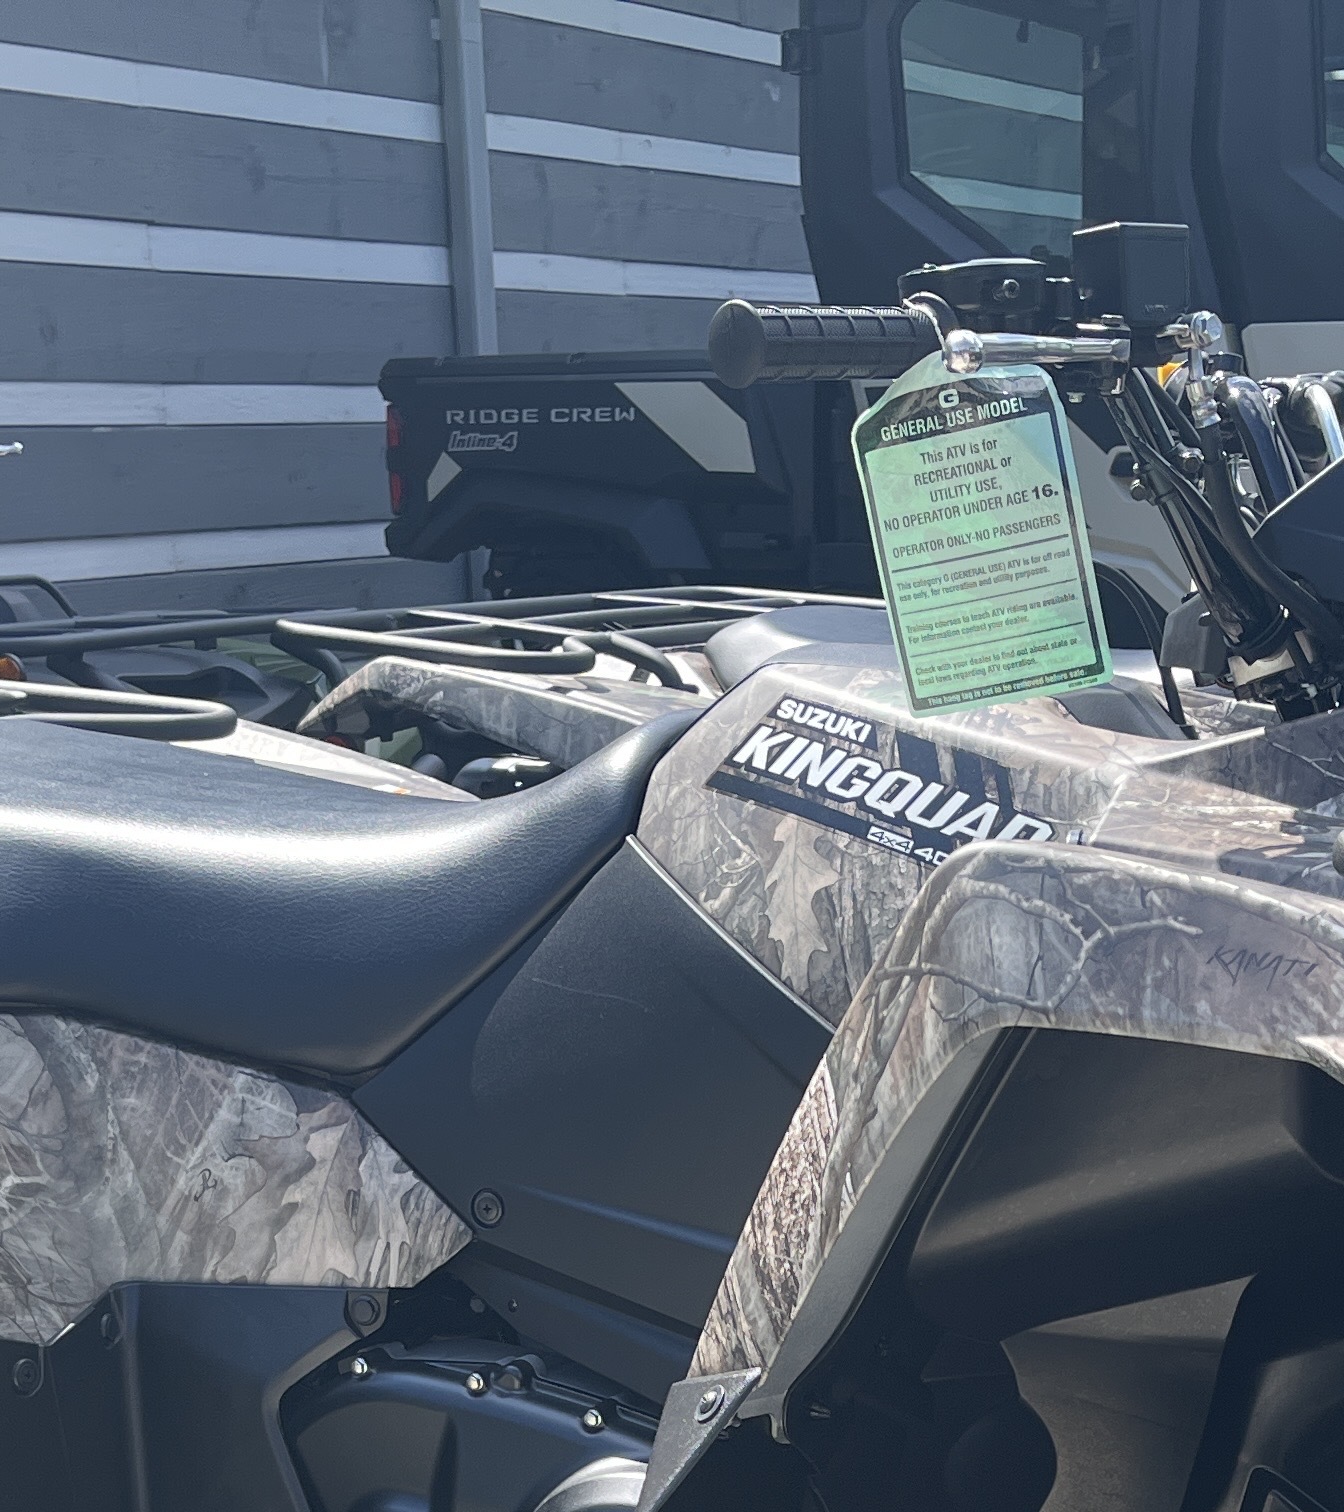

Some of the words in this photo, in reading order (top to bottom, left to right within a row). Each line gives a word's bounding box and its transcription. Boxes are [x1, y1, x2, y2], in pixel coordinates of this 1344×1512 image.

[938, 390, 960, 408] G
[446, 408, 539, 425] RIDGE
[550, 406, 636, 423] CREW
[881, 416, 943, 441] GENERAL
[947, 409, 974, 426] USE
[977, 397, 1028, 419] MODEL
[448, 430, 518, 451] Inline-4
[920, 449, 943, 465] This
[945, 444, 967, 459] ATV
[969, 441, 980, 454] is
[982, 437, 998, 451] for
[914, 458, 998, 486] RECREATIONAL
[1000, 456, 1012, 468] or
[930, 484, 971, 502] UTILITY
[975, 476, 1002, 494] USE,
[884, 518, 900, 532] NO
[902, 505, 961, 528] OPERATOR
[963, 496, 1003, 515] UNDER
[1005, 490, 1029, 506] AGE
[1032, 483, 1058, 500] 16.
[893, 539, 944, 558] OPERATOR
[993, 514, 1061, 537] PASSENGERS
[776, 699, 872, 743] SUZUKI
[868, 829, 913, 852] 4x4
[914, 847, 950, 866] 40
